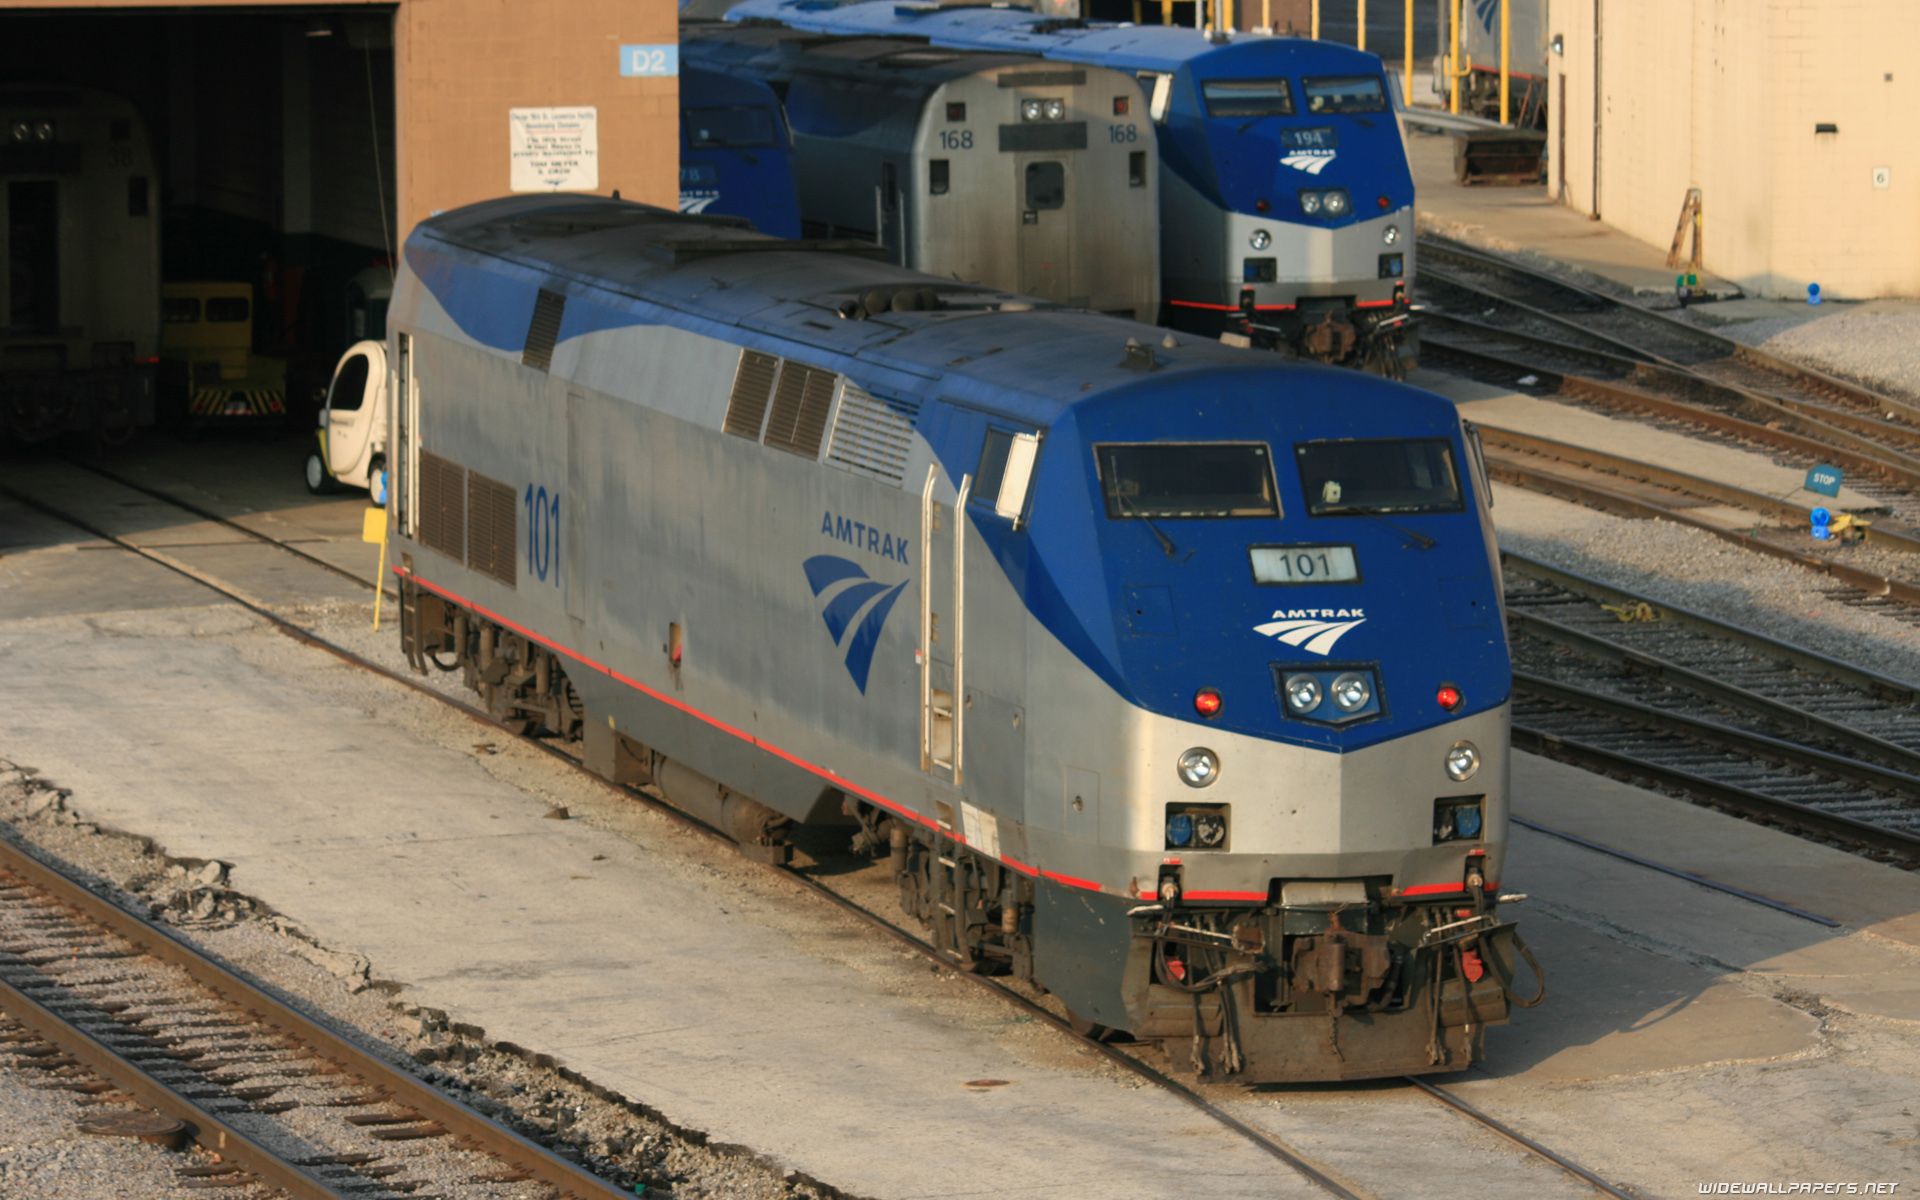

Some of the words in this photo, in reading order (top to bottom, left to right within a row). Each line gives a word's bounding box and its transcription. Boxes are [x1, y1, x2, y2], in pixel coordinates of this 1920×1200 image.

[632, 49, 666, 72] D2
[939, 129, 974, 150] 168
[1108, 124, 1138, 144] 168
[1289, 149, 1336, 157] AMTRAK
[1876, 173, 1886, 184] 6
[1813, 472, 1837, 486] STOP
[524, 482, 560, 588] 101
[821, 510, 909, 566] AMTRAK
[1280, 553, 1330, 577] 101
[1271, 608, 1366, 619] AMTRAK
